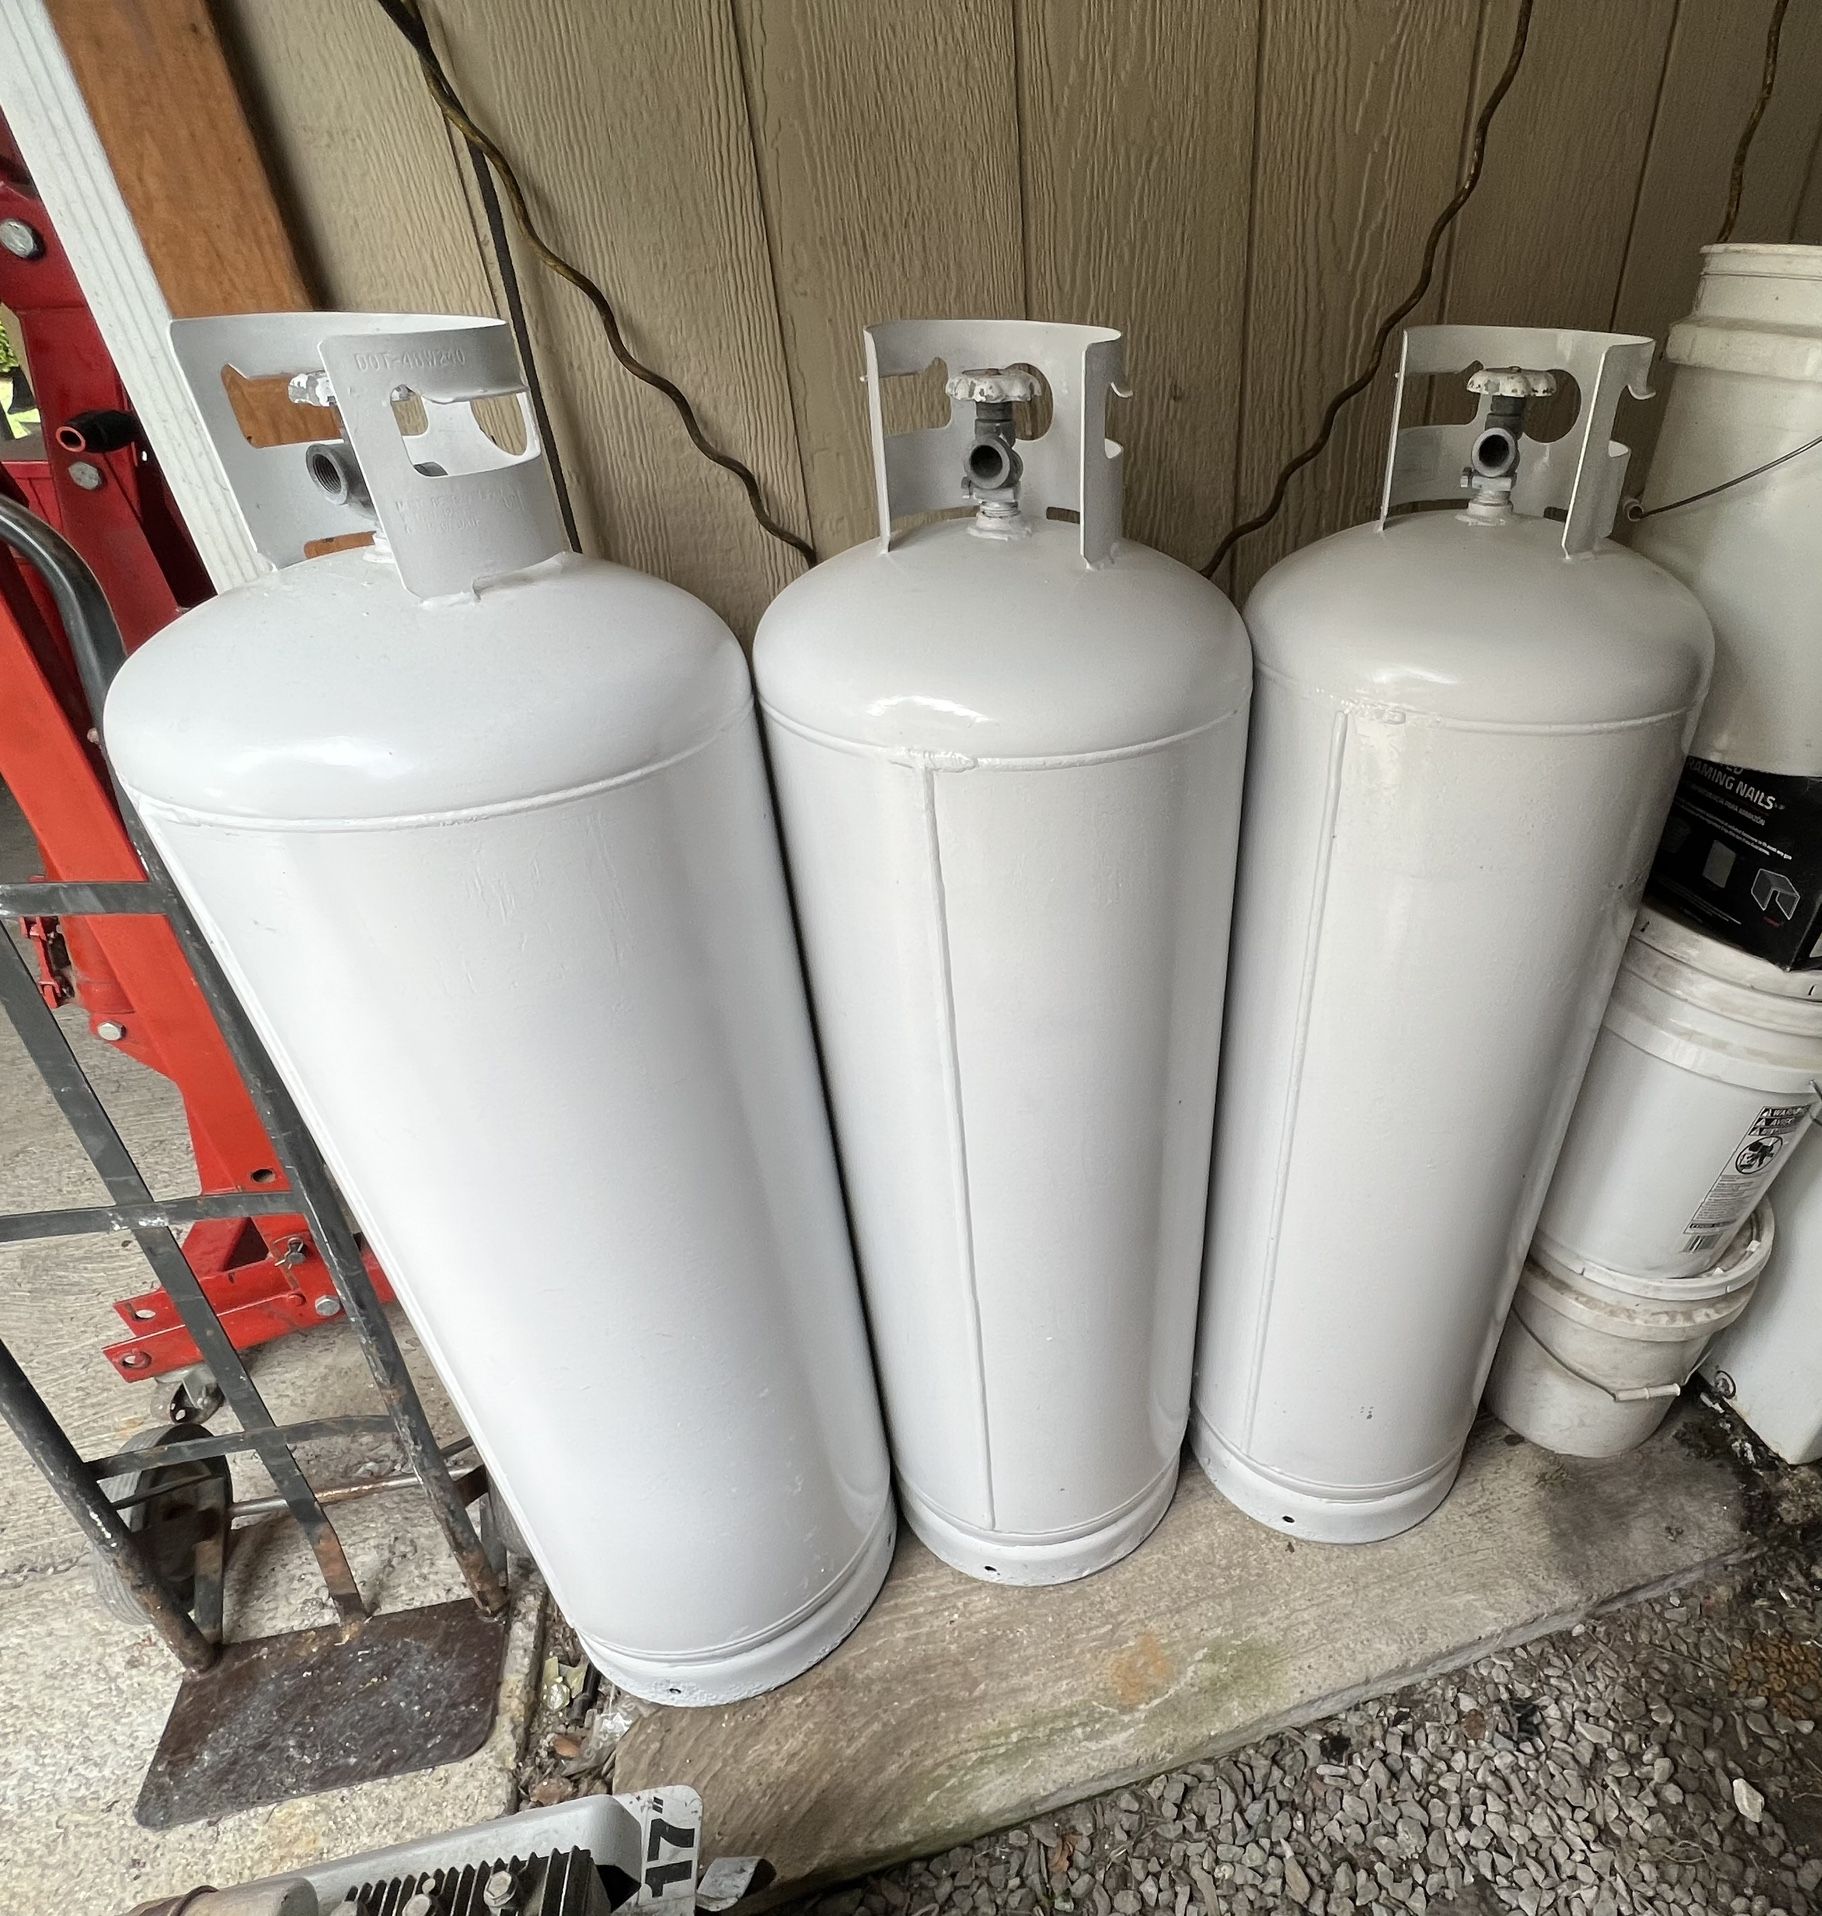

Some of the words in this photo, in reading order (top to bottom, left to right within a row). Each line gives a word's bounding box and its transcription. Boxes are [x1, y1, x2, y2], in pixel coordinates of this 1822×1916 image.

[1686, 757, 1735, 791] RAMING
[1735, 780, 1776, 810] NAILS
[644, 1796, 696, 1898] 17"
